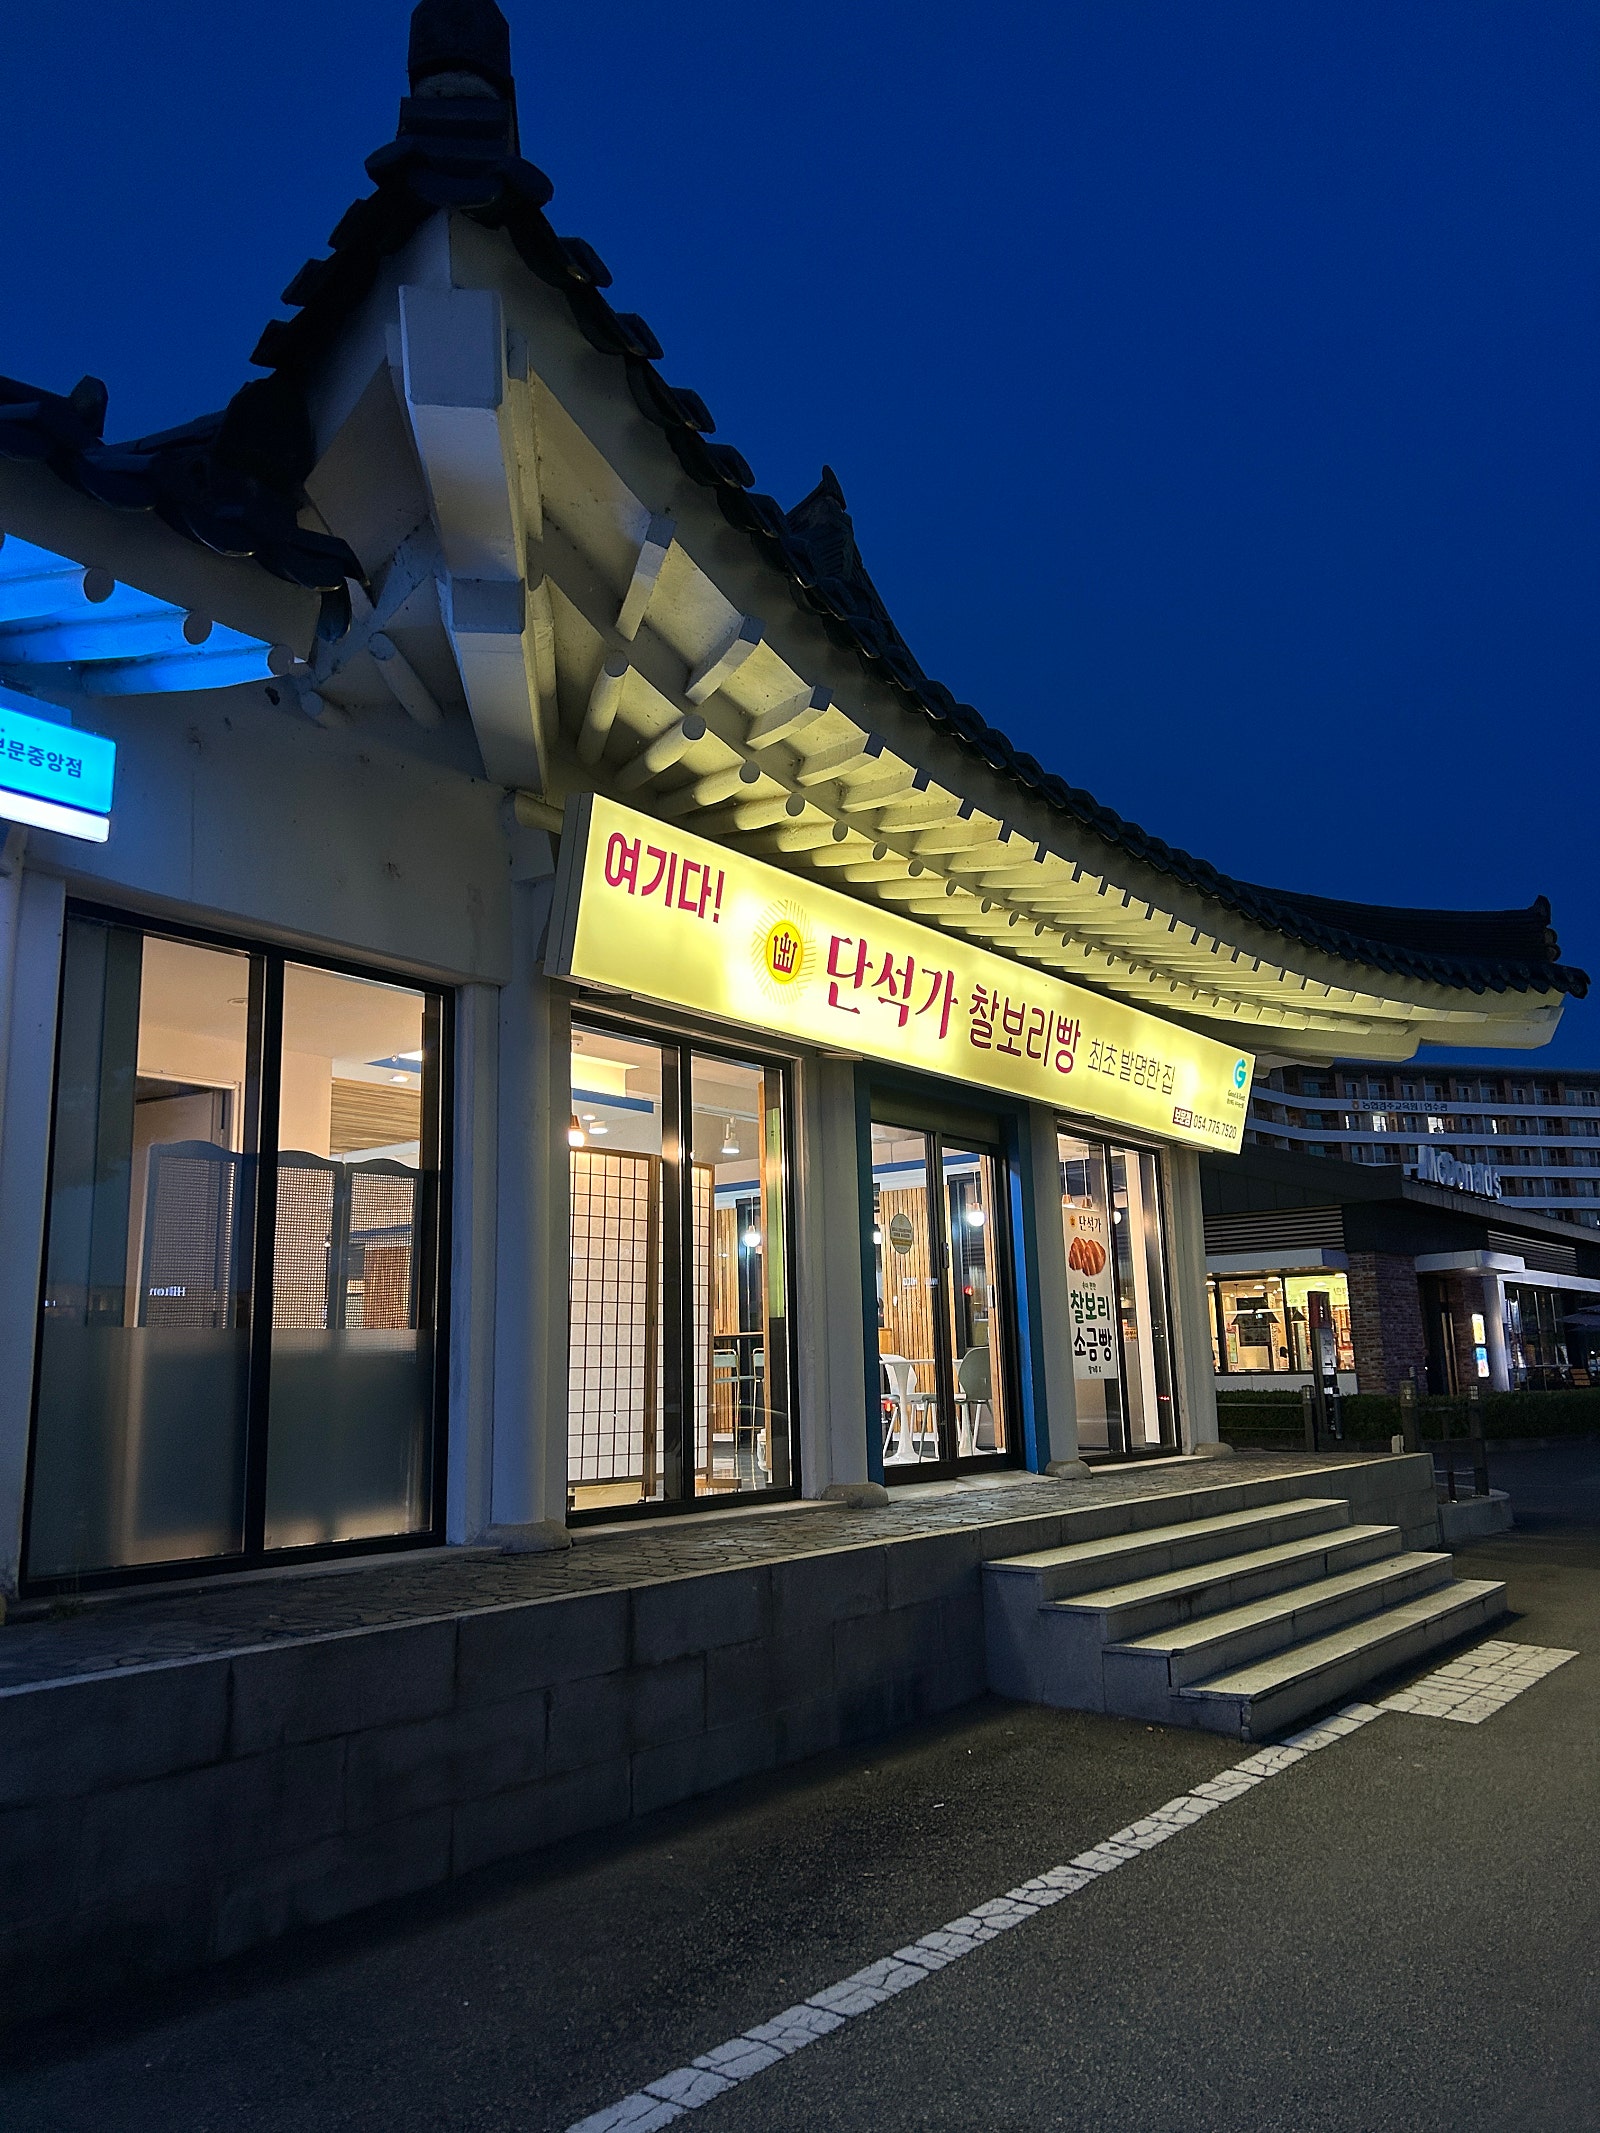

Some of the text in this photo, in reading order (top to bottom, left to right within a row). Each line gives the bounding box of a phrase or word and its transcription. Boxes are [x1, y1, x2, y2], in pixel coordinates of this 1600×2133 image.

[604, 831, 726, 924] 여기다!
[826, 935, 1176, 1096] 단석가 찰보리빵 최초 발명한 집
[1193, 1114, 1237, 1139] 054.775.7520
[1078, 1214, 1102, 1233] 단석가
[1070, 1289, 1111, 1324] 찰보리
[1073, 1326, 1113, 1362] 소금빵
